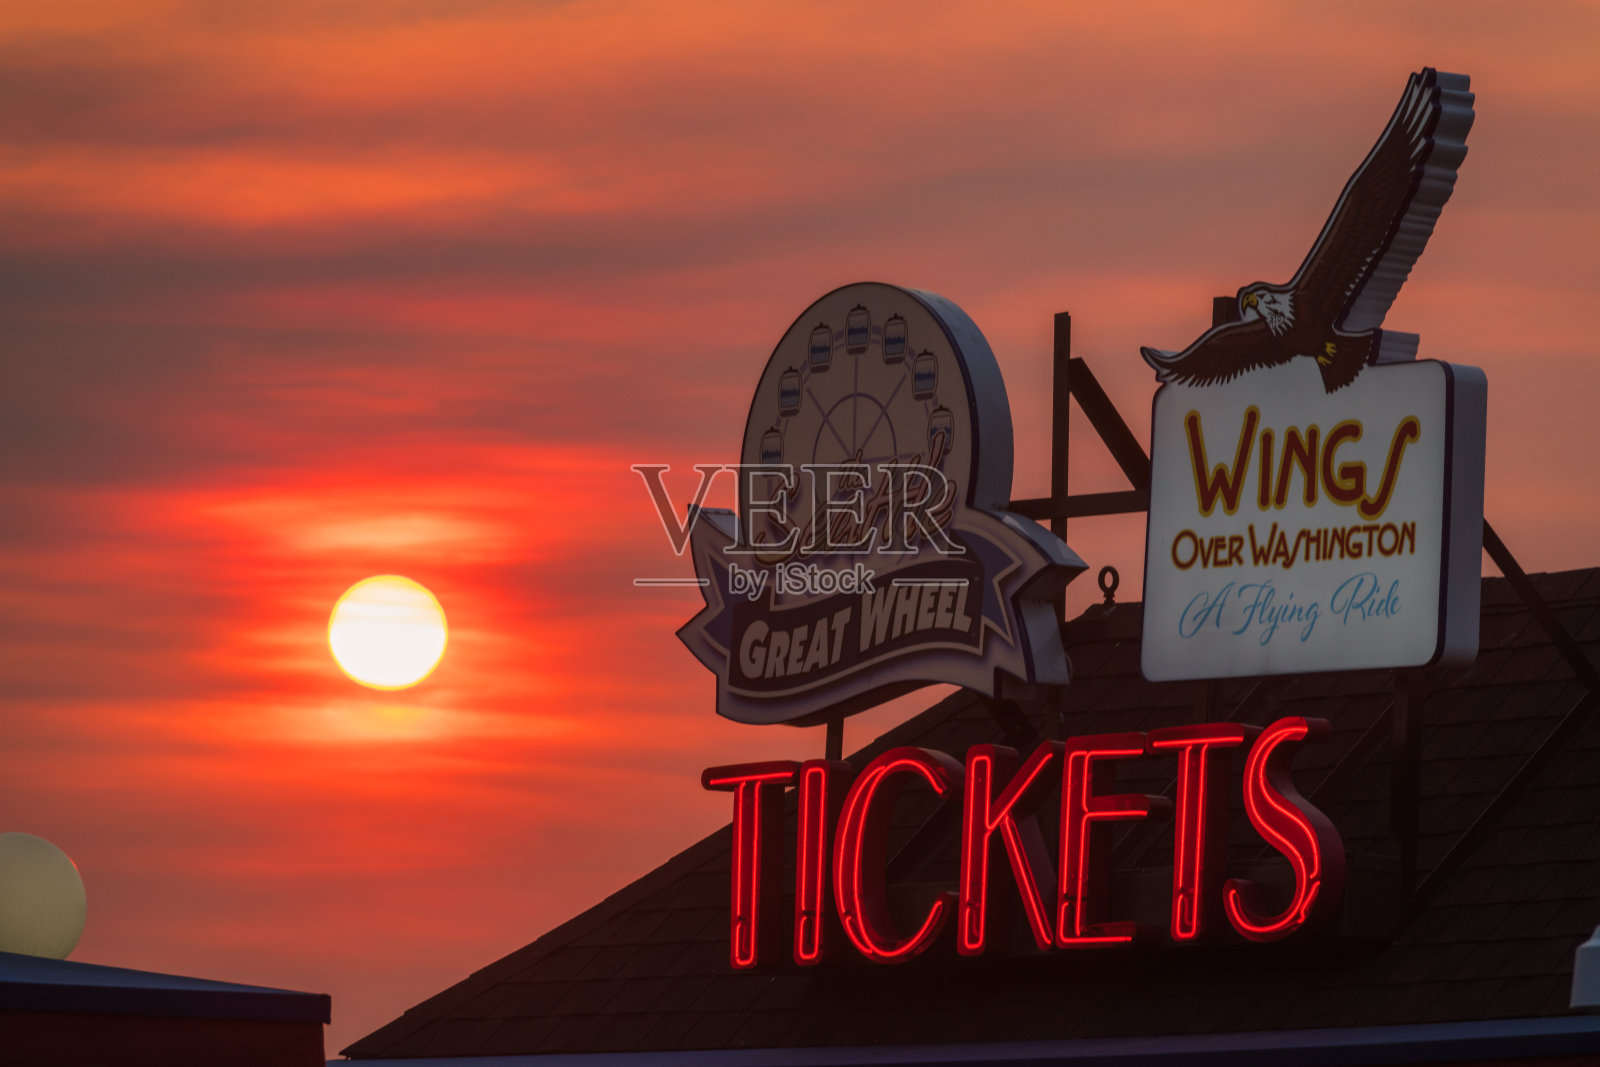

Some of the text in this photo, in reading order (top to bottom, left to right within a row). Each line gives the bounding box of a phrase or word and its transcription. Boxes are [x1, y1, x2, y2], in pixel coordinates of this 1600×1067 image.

[1184, 405, 1421, 521] WINGS
[1171, 521, 1416, 570] OVER WASHINGTON
[739, 579, 972, 680] GREAT WHEEL
[1178, 572, 1402, 646] A Flying Ride
[702, 716, 1330, 969] TICKETS
